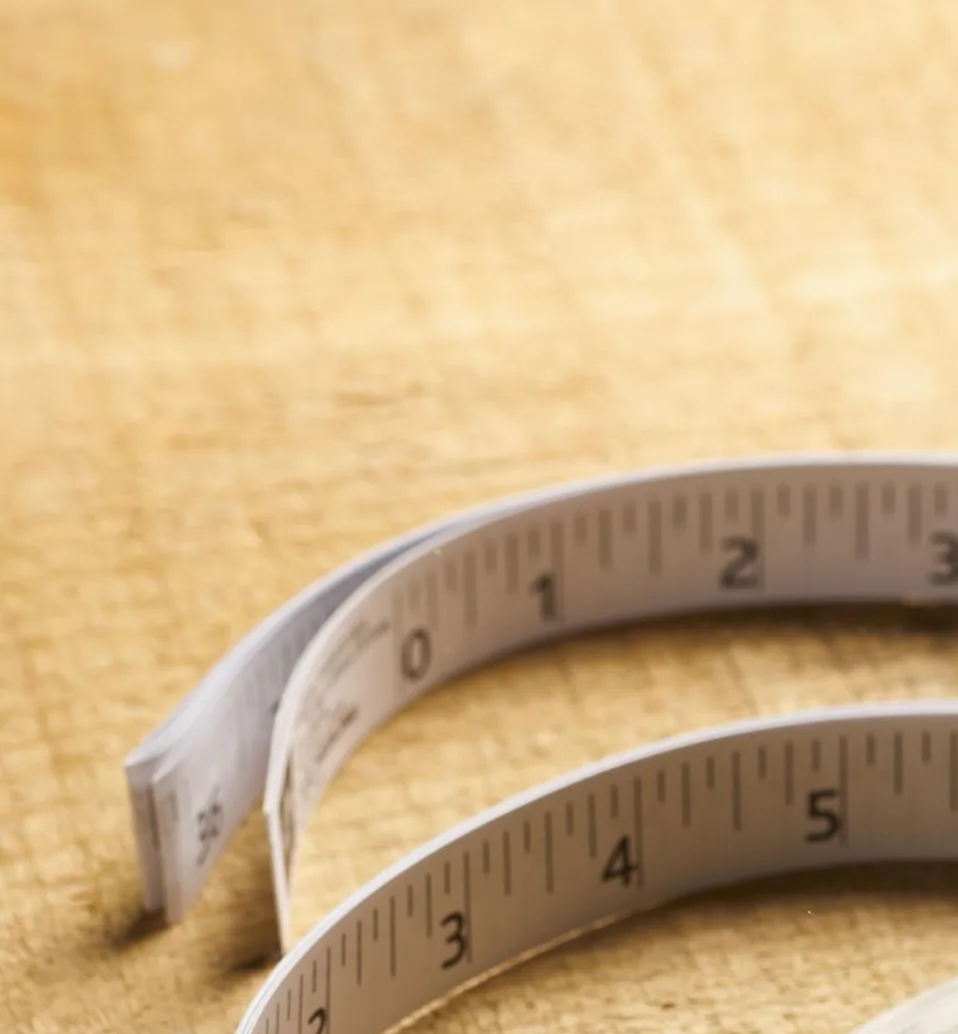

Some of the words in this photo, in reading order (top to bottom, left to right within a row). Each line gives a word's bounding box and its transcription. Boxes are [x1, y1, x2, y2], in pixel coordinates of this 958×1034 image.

[401, 628, 432, 681] 0
[529, 571, 556, 620] 1
[718, 536, 760, 591] 2
[440, 912, 466, 970] 3
[602, 834, 638, 887] 4
[805, 789, 842, 842] 5
